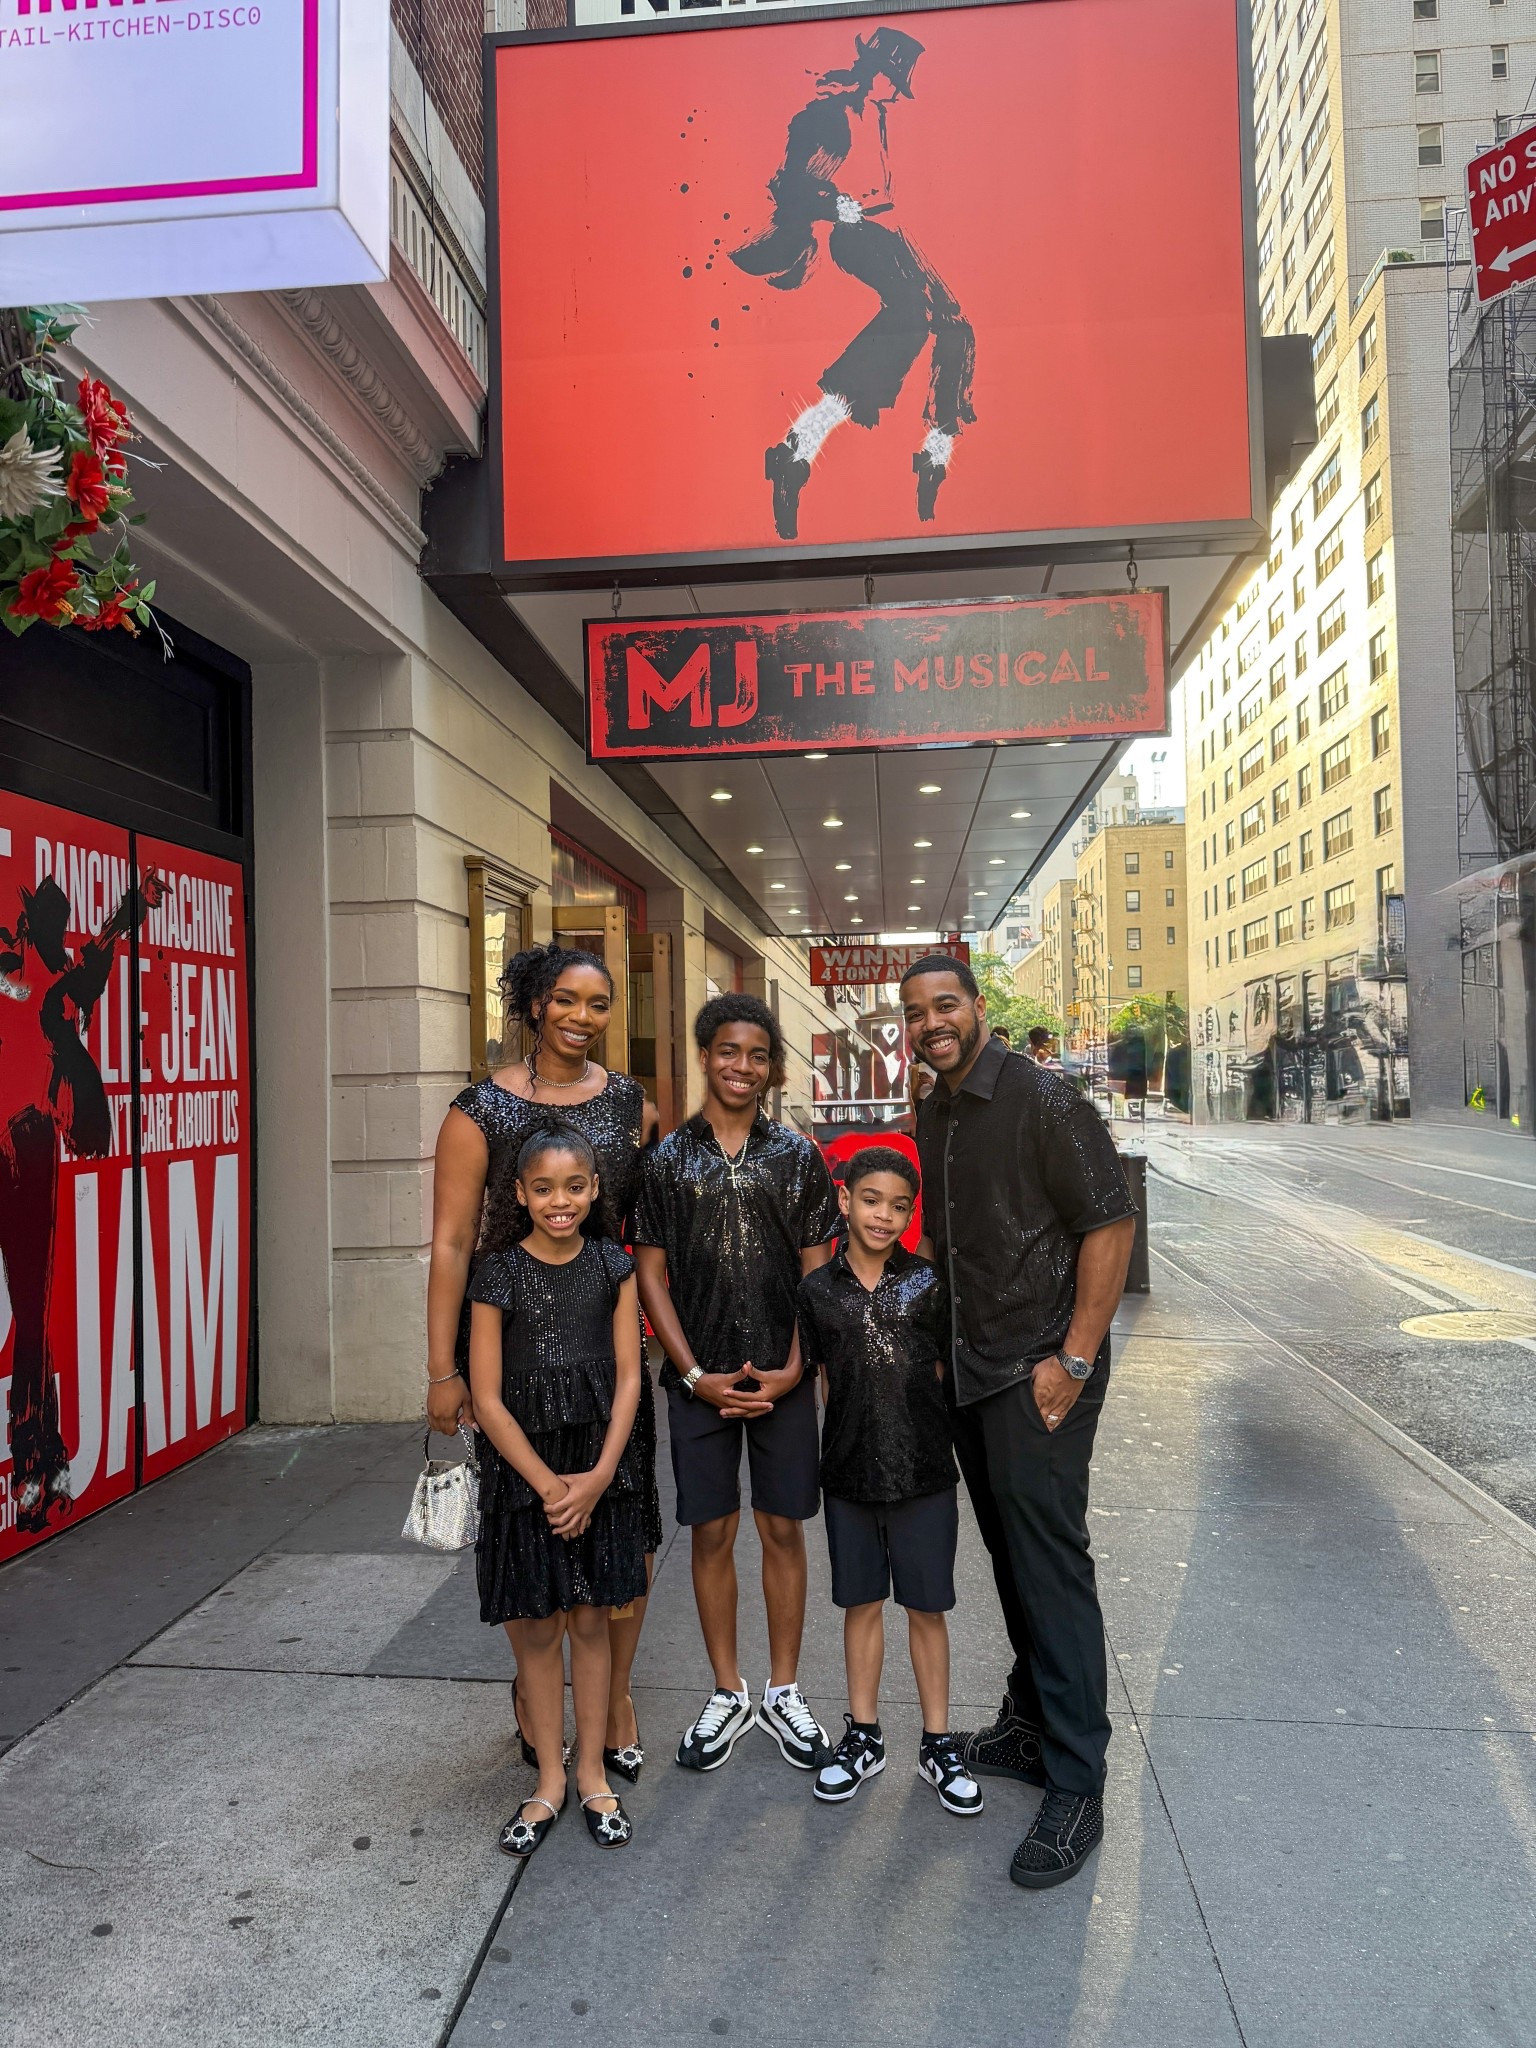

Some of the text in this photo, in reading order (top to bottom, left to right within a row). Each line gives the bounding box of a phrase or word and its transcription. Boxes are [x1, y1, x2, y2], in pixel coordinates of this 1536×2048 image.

[1480, 155, 1516, 195] NO
[1485, 177, 1536, 227] Any
[627, 640, 1109, 730] MJ THE MUSICAL
[147, 866, 235, 957] MACHINE
[821, 967, 831, 982] 4
[835, 966, 880, 982] TONY
[161, 962, 238, 1084] JEAN
[140, 1093, 173, 1155] CARE
[176, 1090, 219, 1149] ABOUT
[222, 1089, 239, 1145] US
[66, 1153, 239, 1500] JAM
